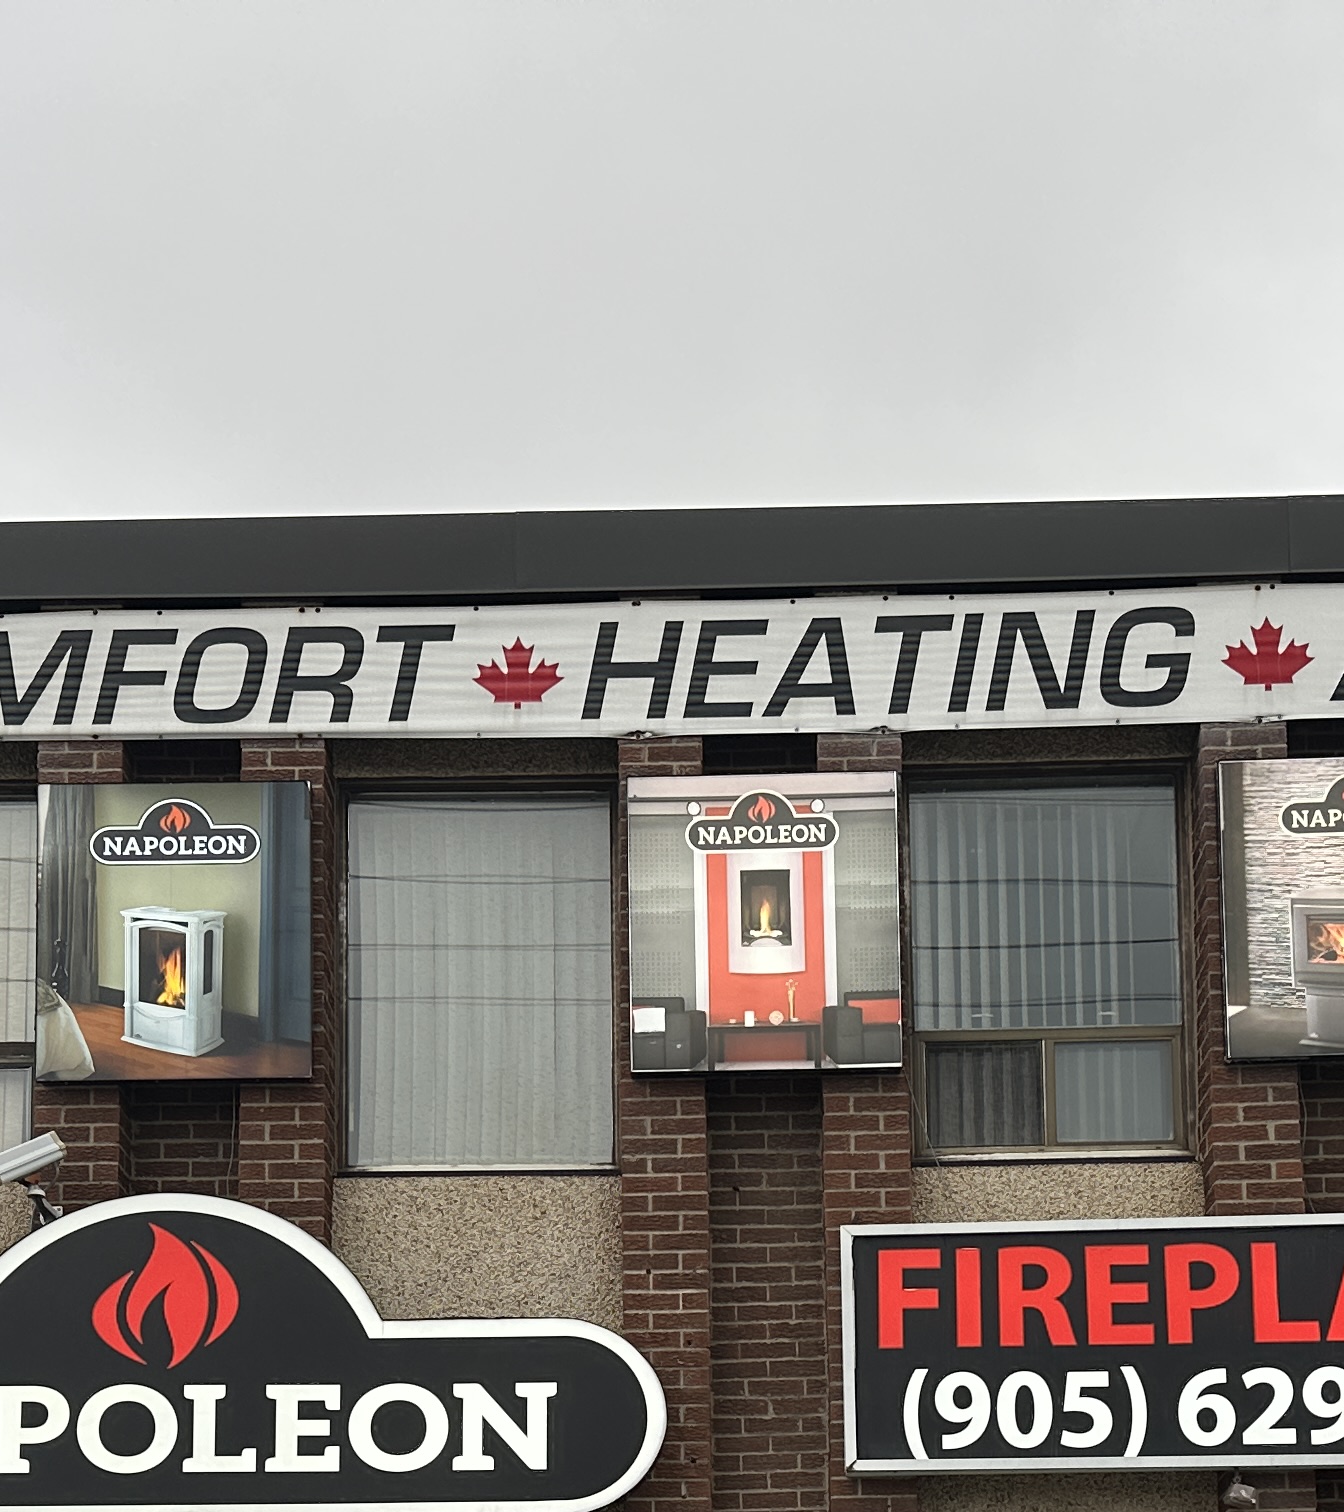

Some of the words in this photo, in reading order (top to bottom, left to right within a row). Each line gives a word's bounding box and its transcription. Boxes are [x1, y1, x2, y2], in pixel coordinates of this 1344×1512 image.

[581, 607, 1196, 720] HEATING
[102, 835, 247, 856] NAPOLEON
[697, 823, 827, 845] NAPOLEON
[902, 1365, 1149, 1461] (905)
